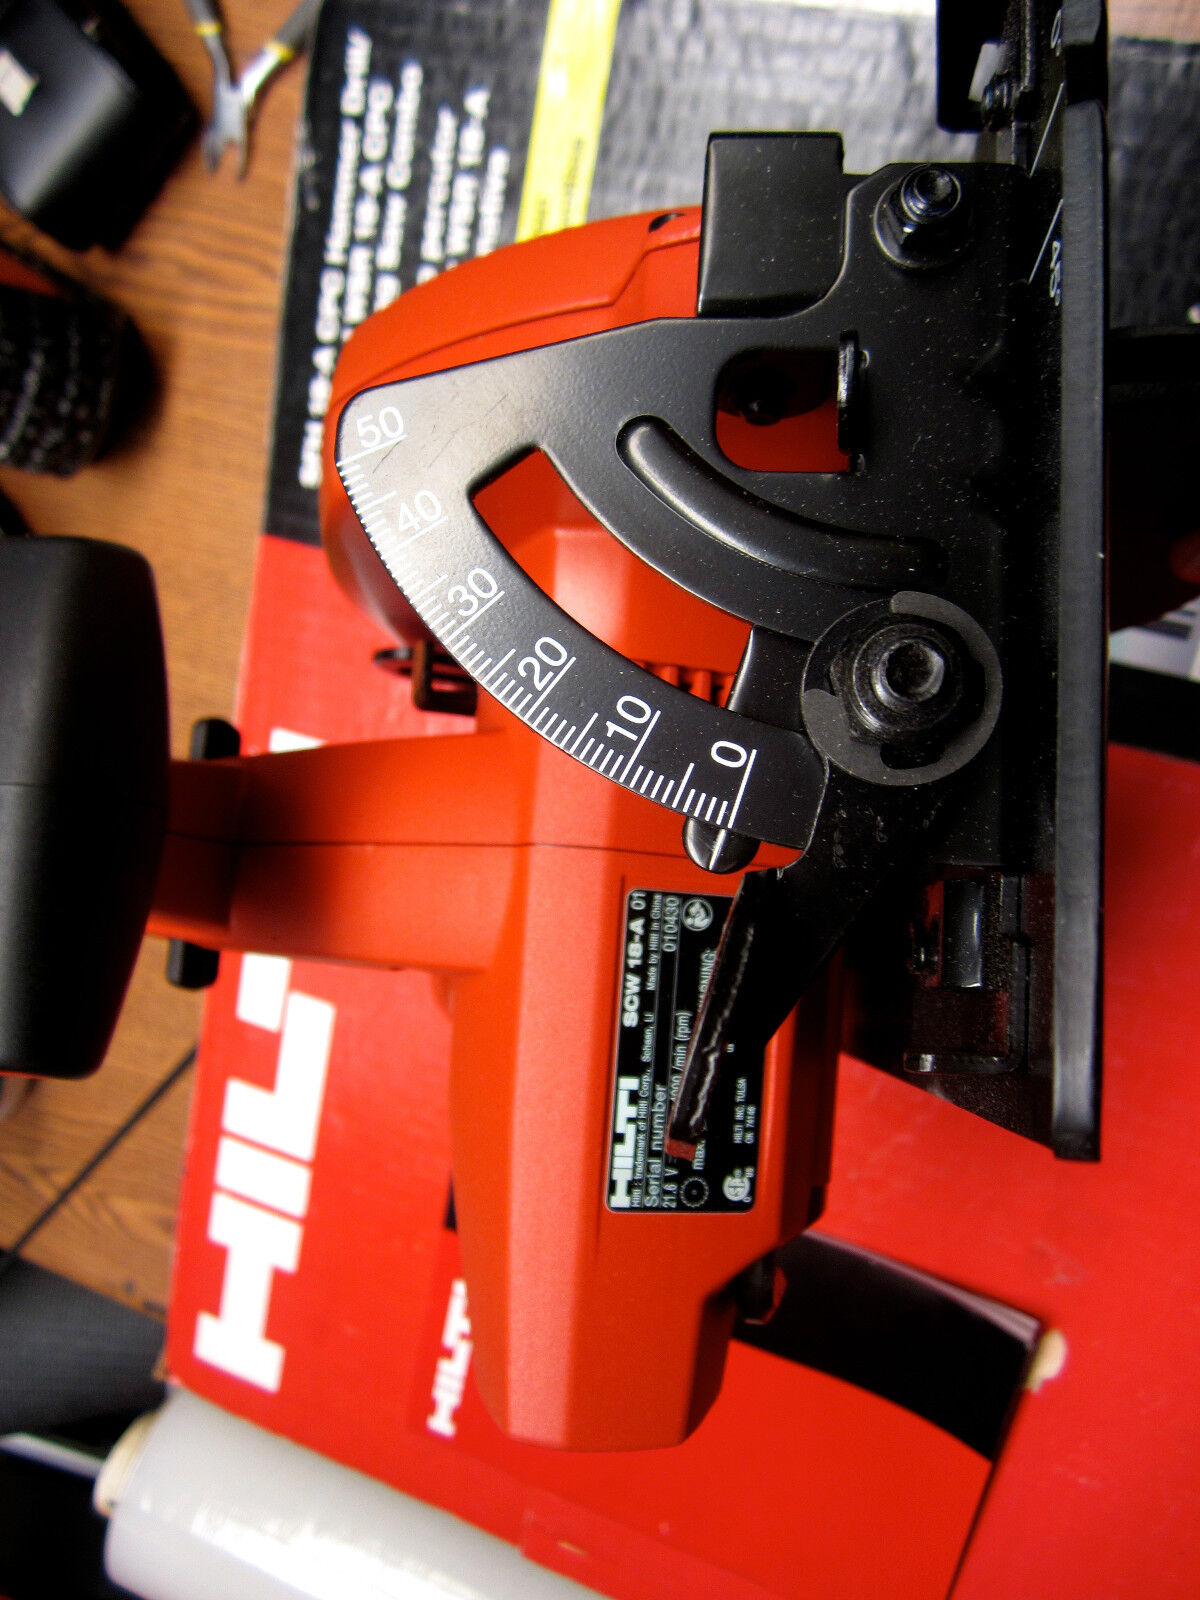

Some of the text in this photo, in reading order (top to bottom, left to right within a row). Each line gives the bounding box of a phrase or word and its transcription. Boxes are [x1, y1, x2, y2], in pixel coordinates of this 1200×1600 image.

[385, 62, 423, 189] Combo
[324, 119, 361, 264] Hammer
[376, 193, 407, 270] Saw
[356, 405, 405, 447] 50
[396, 489, 442, 530] 40
[447, 567, 499, 616] 30
[517, 636, 569, 688] 20
[605, 695, 652, 741] 10
[710, 740, 747, 768] 0
[652, 894, 662, 919] China
[650, 934, 659, 950] Hilti
[648, 954, 658, 964] by
[646, 967, 656, 990] Made
[674, 1012, 693, 1041] (rpm)
[610, 892, 646, 1208] HILTI SCW 18-A 01
[641, 1026, 655, 1062] Schaan,
[644, 896, 679, 1208] Serial number 010430
[672, 1045, 687, 1071] /min
[693, 950, 717, 1170] max. RNING:
[735, 1078, 746, 1102] TULSA
[638, 1100, 648, 1118] Hilti
[745, 1105, 756, 1144] OK 74146
[638, 1122, 646, 1131] of
[733, 1125, 743, 1144] HILTI
[634, 1134, 645, 1179] trademark
[665, 1168, 679, 1176] V
[631, 1189, 641, 1207] Hilti
[663, 1184, 677, 1208] 21.6
